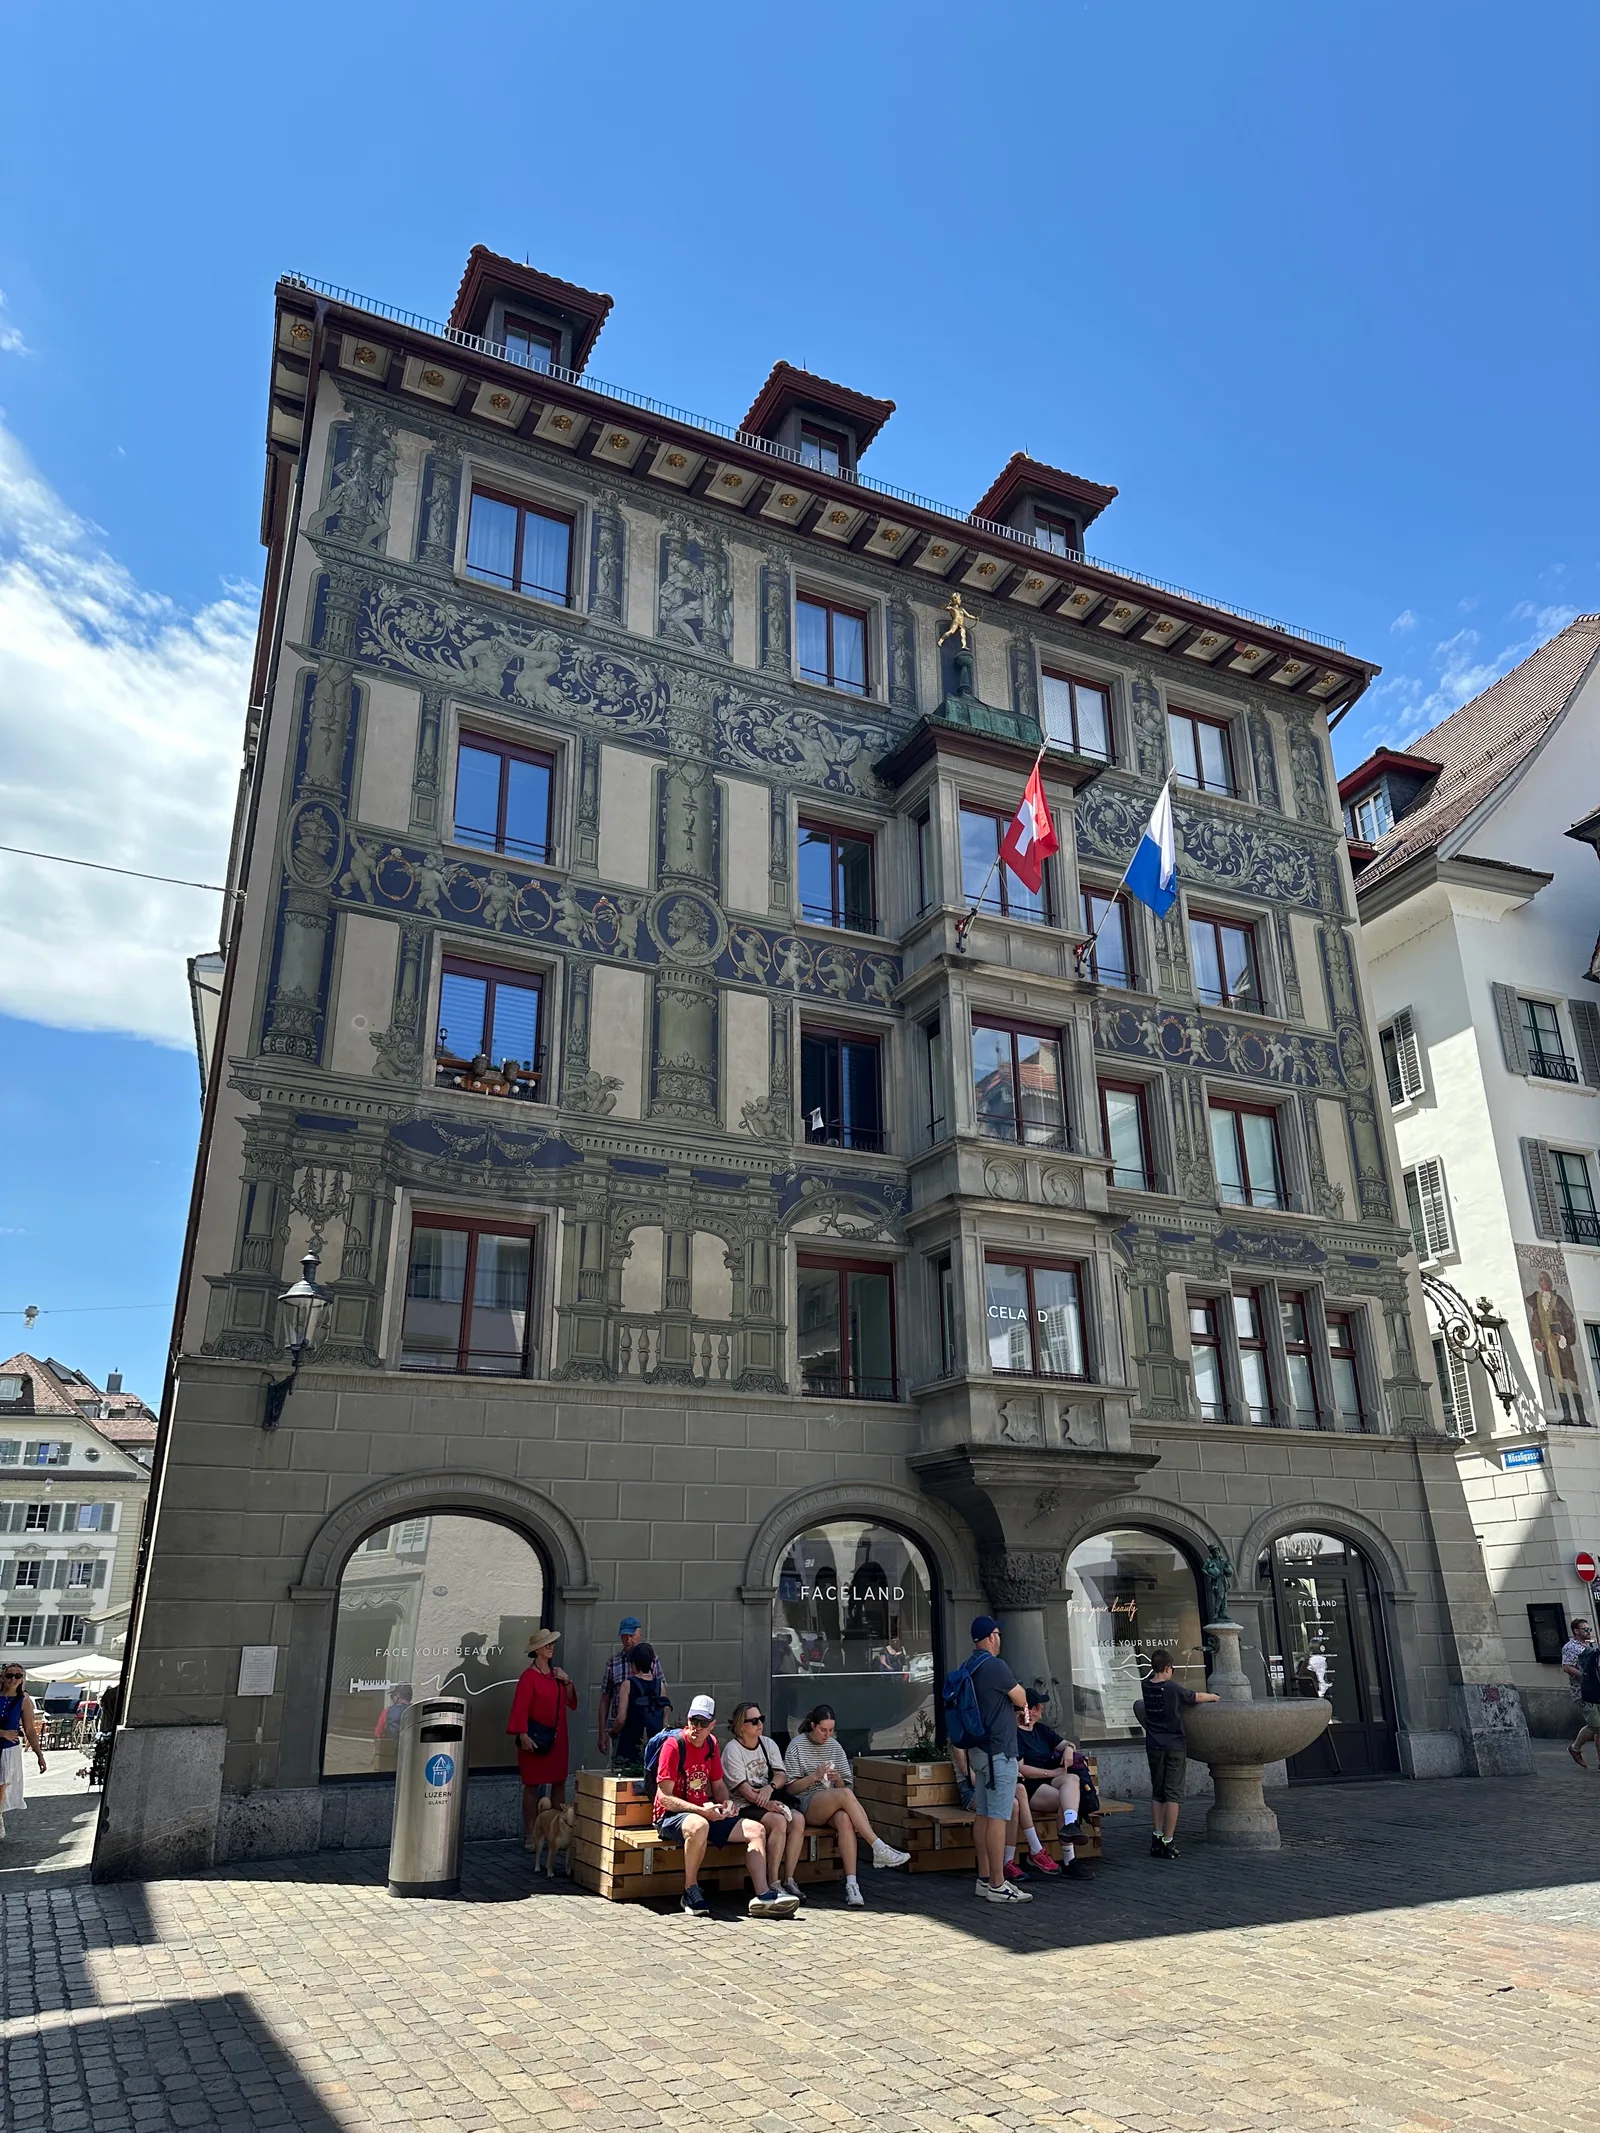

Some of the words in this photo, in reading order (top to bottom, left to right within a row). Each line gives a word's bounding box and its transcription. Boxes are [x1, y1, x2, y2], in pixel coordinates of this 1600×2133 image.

[1529, 1253, 1565, 1265] GOETHE
[801, 1586, 905, 1600] FACELAND
[1067, 1600, 1088, 1618] Face
[1088, 1605, 1108, 1622] your
[1111, 1597, 1138, 1622] beauty
[1119, 1639, 1143, 1647] YOUR
[1146, 1639, 1179, 1647] BEAUTY
[375, 1648, 408, 1657] FACE
[414, 1647, 449, 1656] YOUR
[455, 1646, 504, 1656] BEAUTY
[424, 1791, 452, 1799] LUZERN
